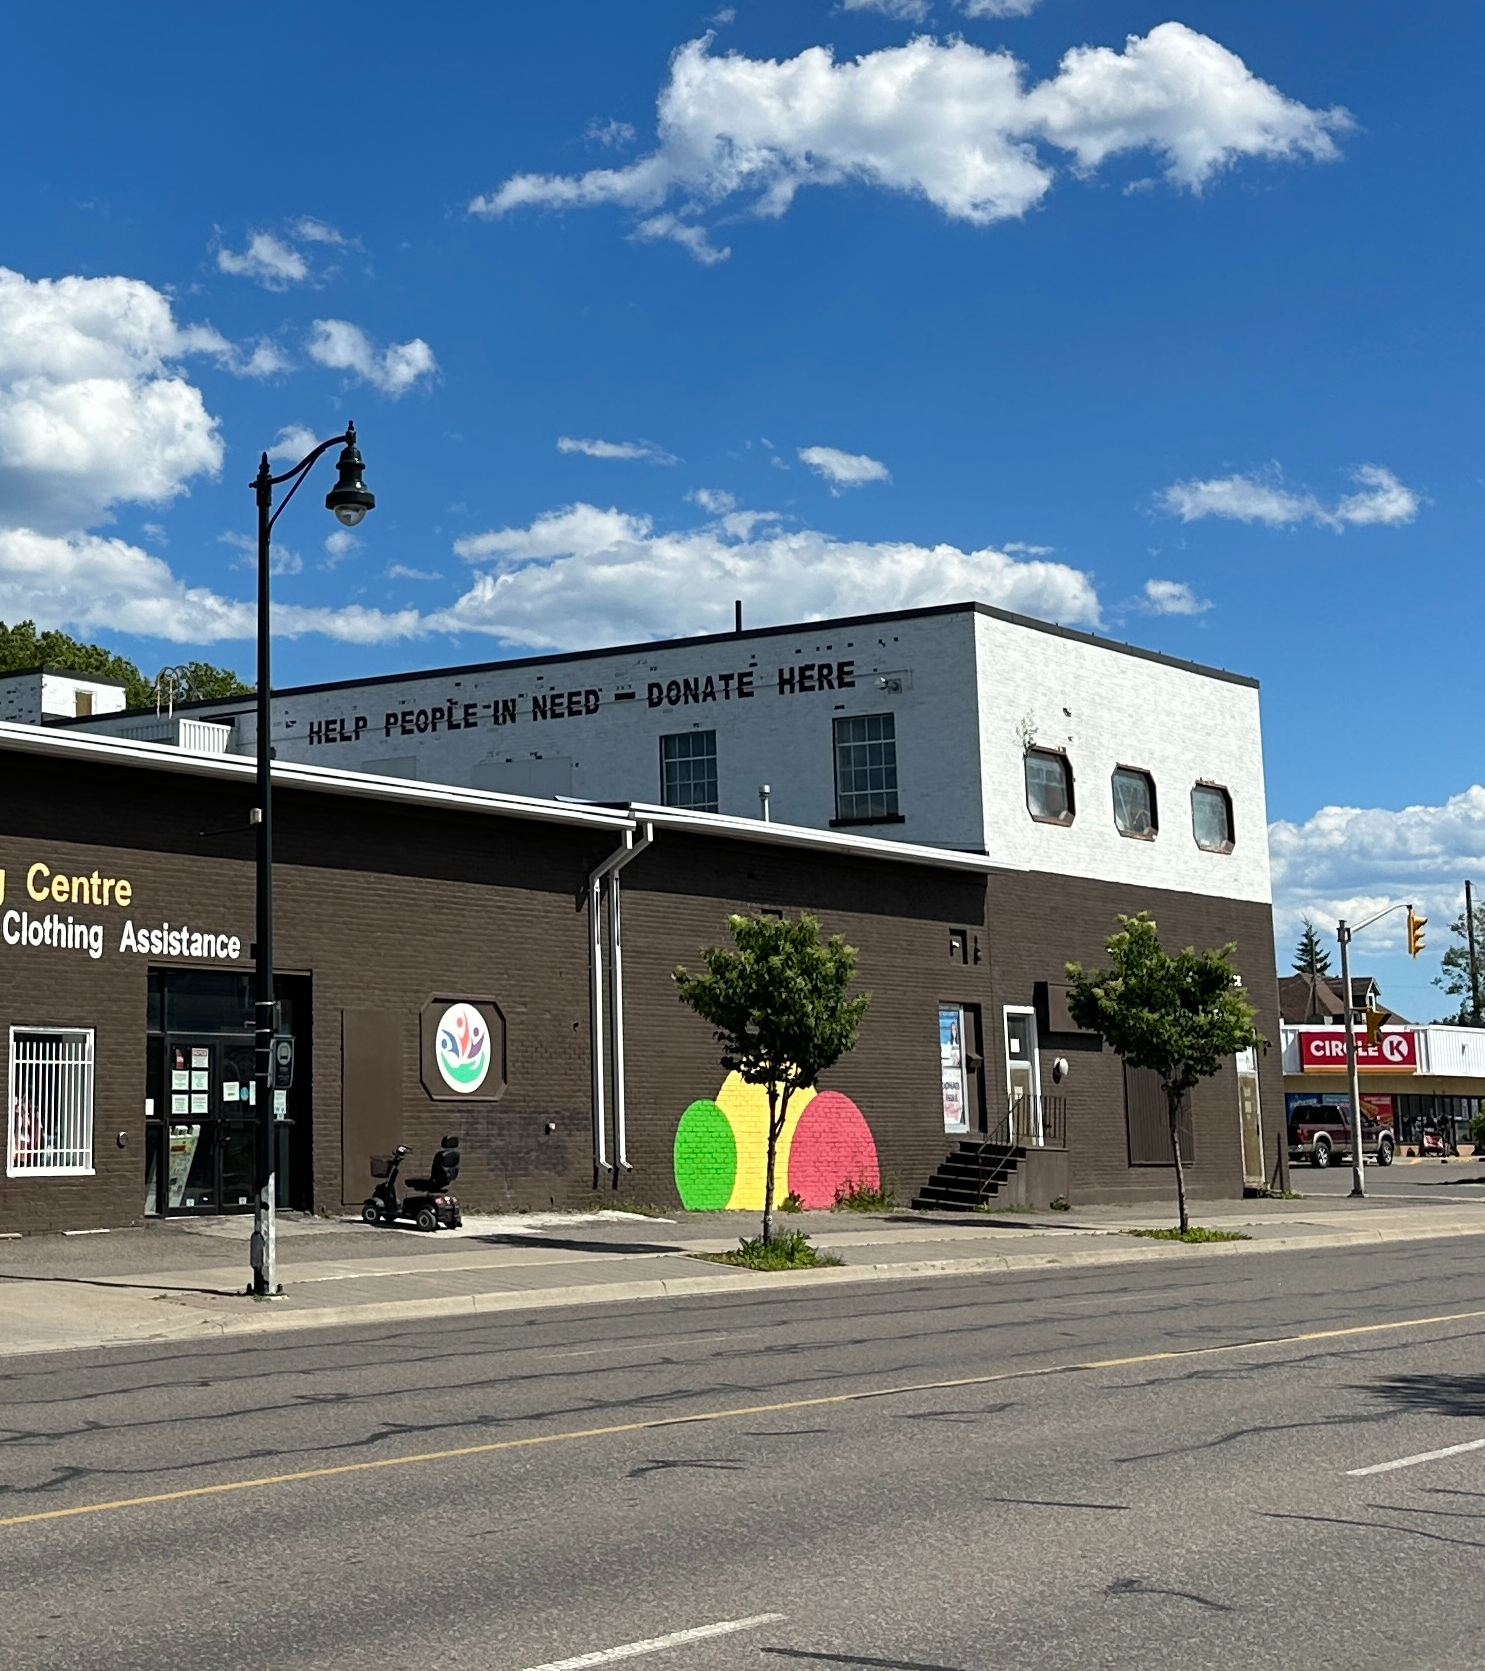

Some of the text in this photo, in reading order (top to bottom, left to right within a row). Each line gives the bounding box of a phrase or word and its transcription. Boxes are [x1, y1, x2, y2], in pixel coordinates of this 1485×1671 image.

[309, 716, 367, 745] HELP
[385, 702, 478, 737] PEOPLE
[493, 698, 516, 725] IN
[532, 689, 600, 721] NEED
[648, 671, 754, 708] DONATE
[779, 661, 856, 694] HERE
[26, 863, 132, 907] Centre
[2, 910, 104, 959] Clothing
[119, 920, 241, 960] Assistance
[1310, 1040, 1379, 1056] CIRLE
